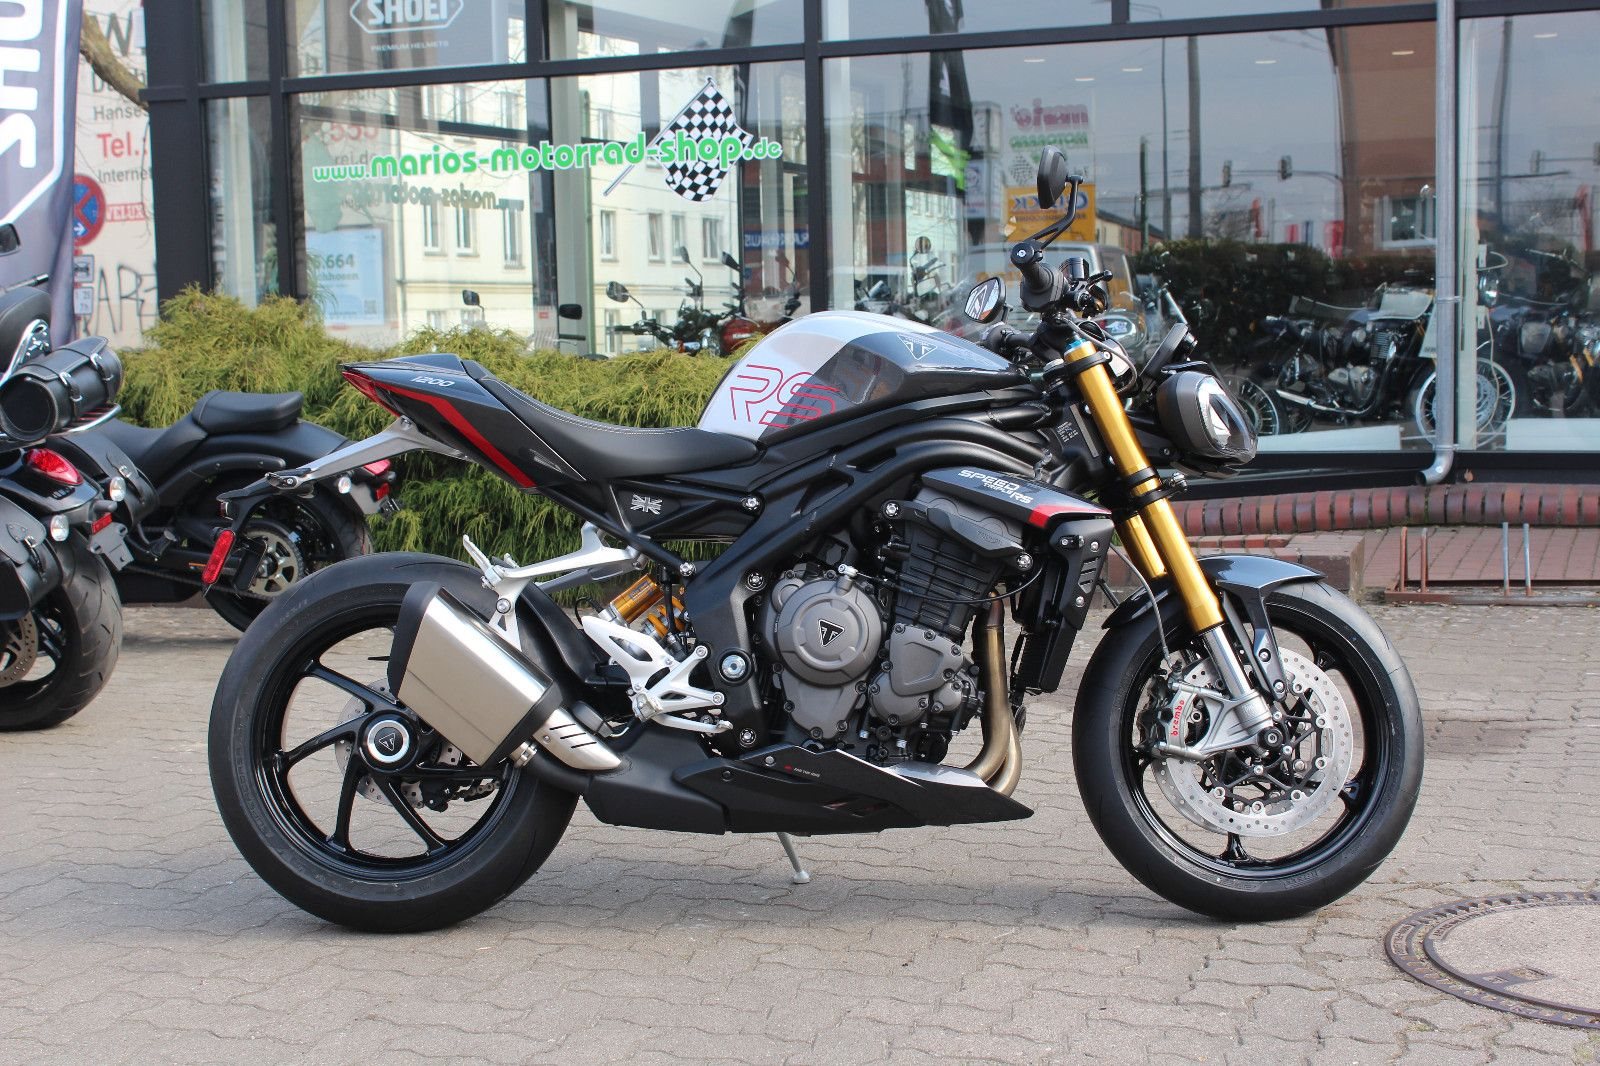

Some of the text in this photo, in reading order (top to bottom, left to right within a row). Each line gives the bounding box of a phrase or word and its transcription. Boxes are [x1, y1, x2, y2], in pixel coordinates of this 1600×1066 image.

[367, 0, 448, 25] SHOEI
[313, 129, 783, 181] www.marios-motorrad-shop.de
[411, 375, 455, 387] 1200
[730, 363, 841, 429] RS
[958, 469, 1020, 491] SPEED
[1009, 491, 1034, 504] RS
[1170, 699, 1185, 737] brembo
